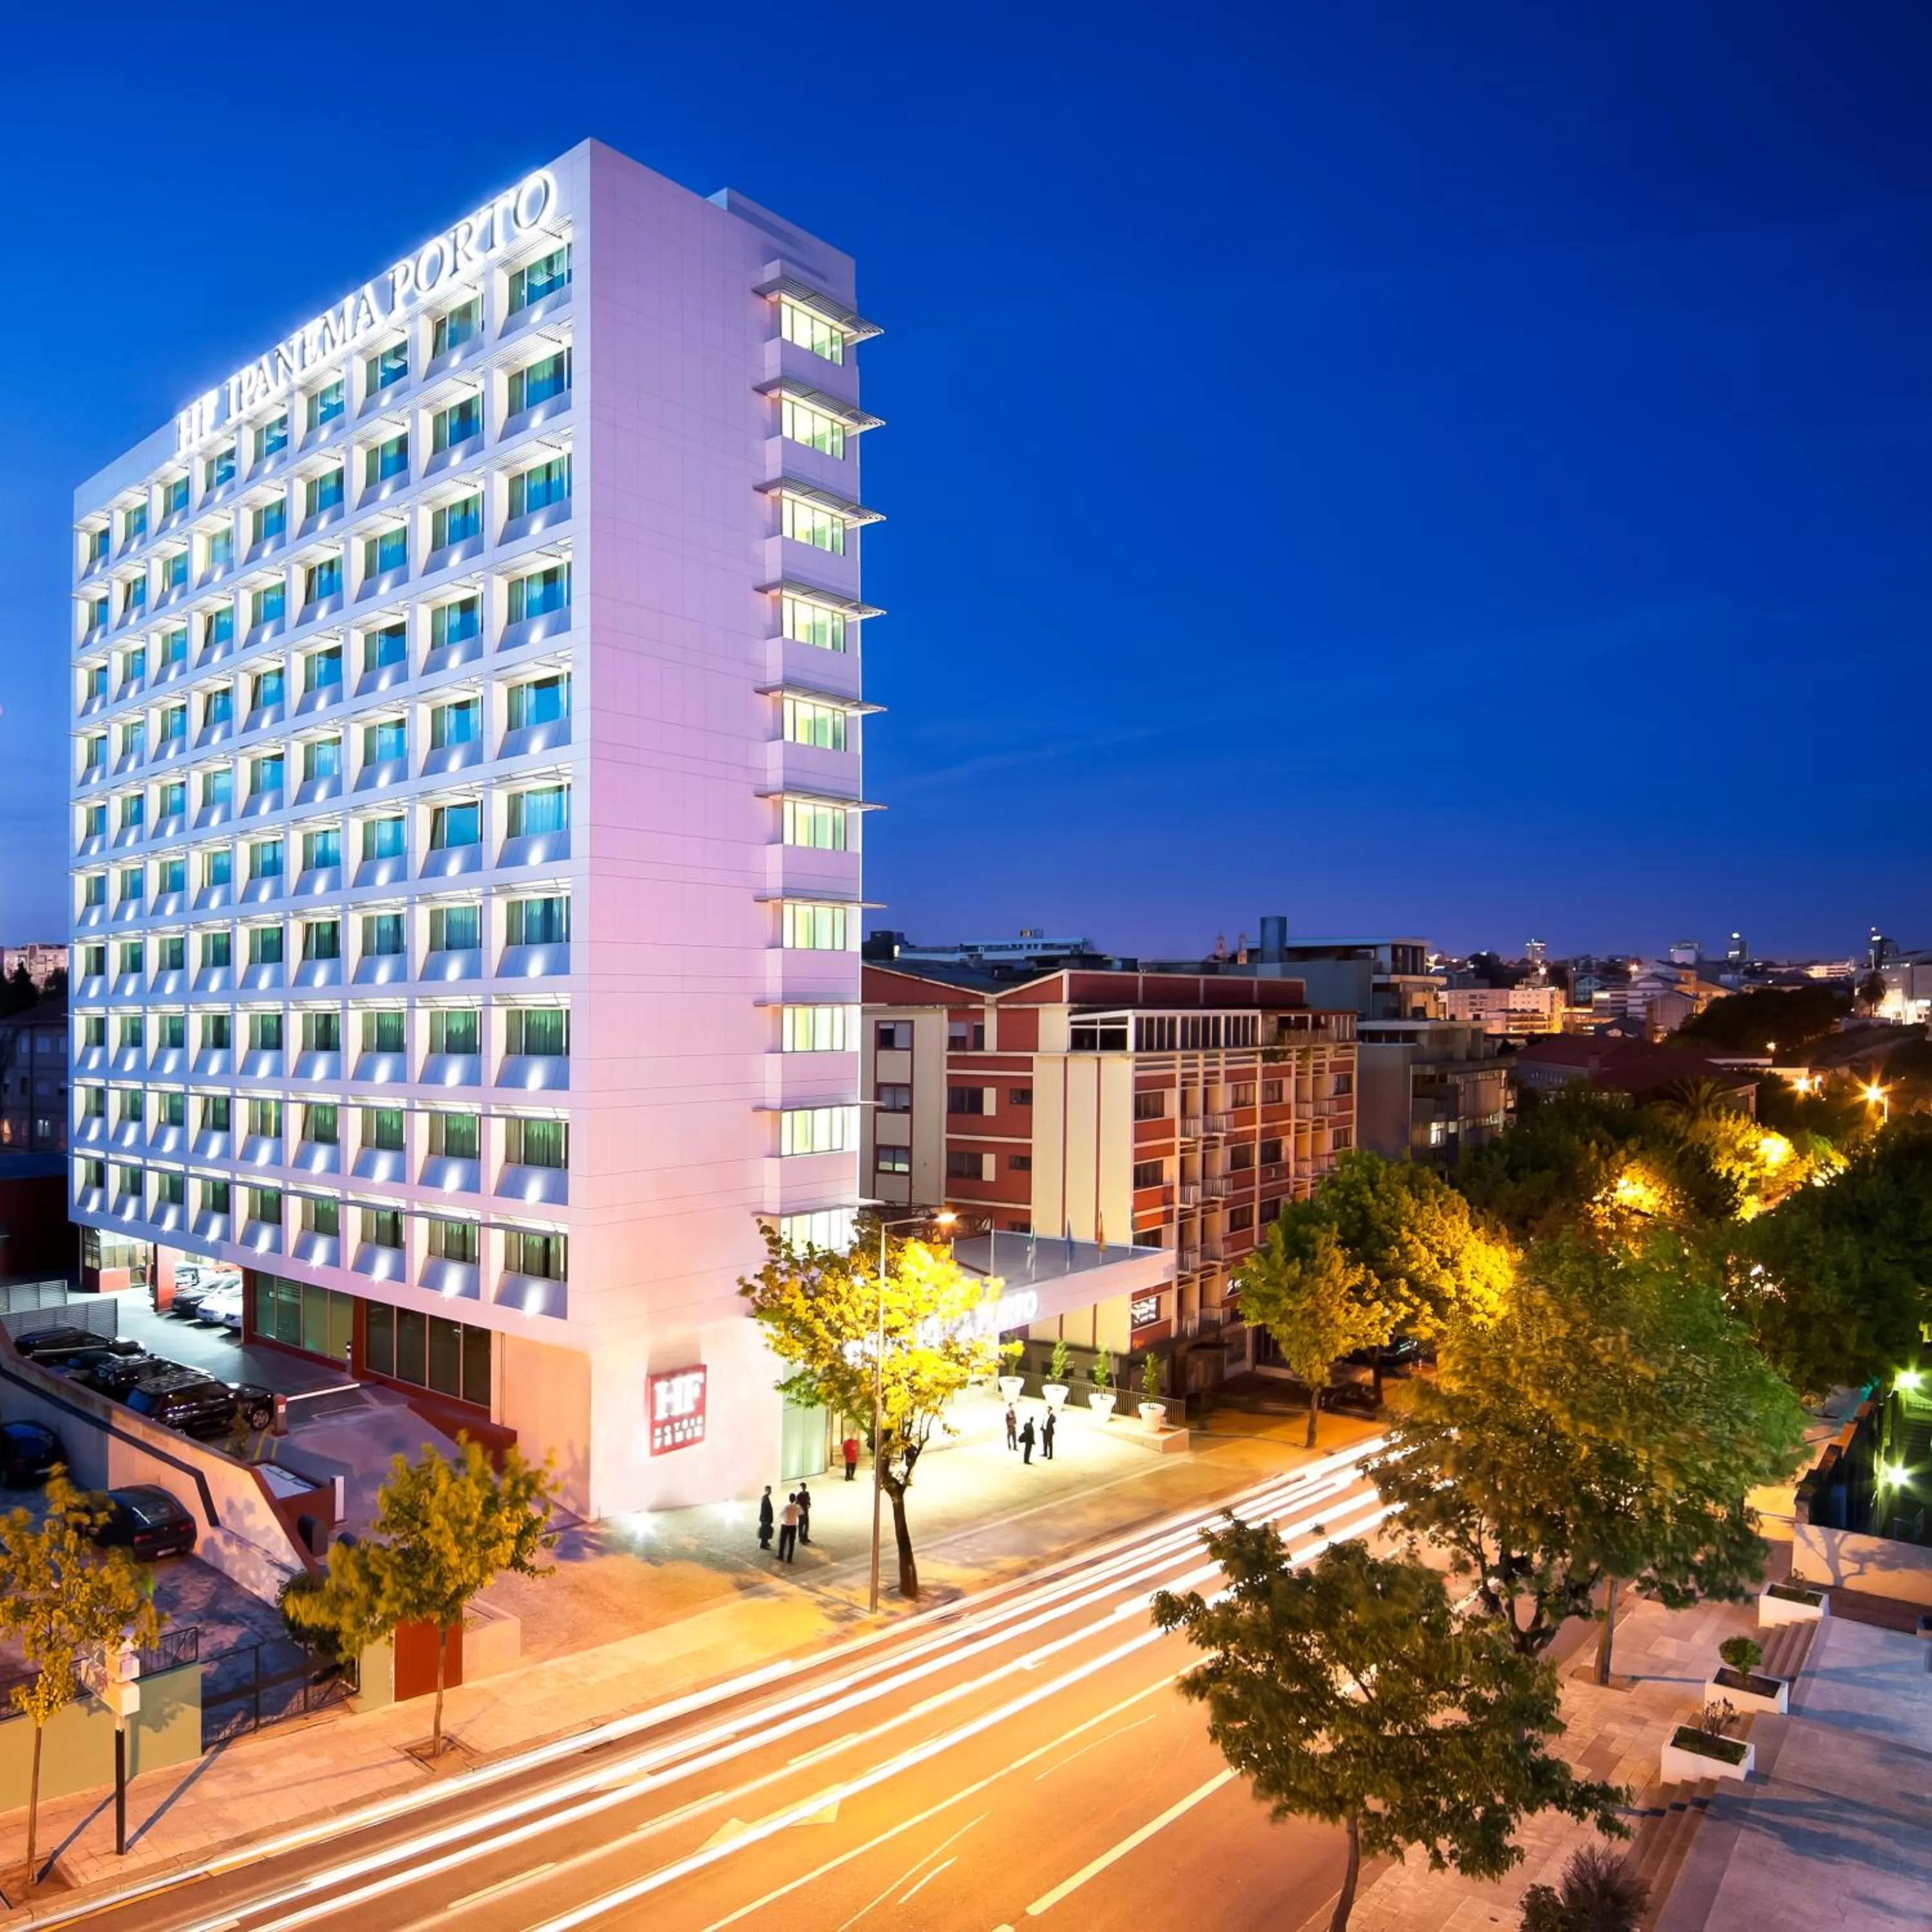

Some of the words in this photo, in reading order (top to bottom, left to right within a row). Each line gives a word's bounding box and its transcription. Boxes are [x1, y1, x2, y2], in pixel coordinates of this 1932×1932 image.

[225, 283, 384, 423] IPANEMA
[388, 169, 556, 316] PORTO
[654, 1372, 705, 1421] HF
